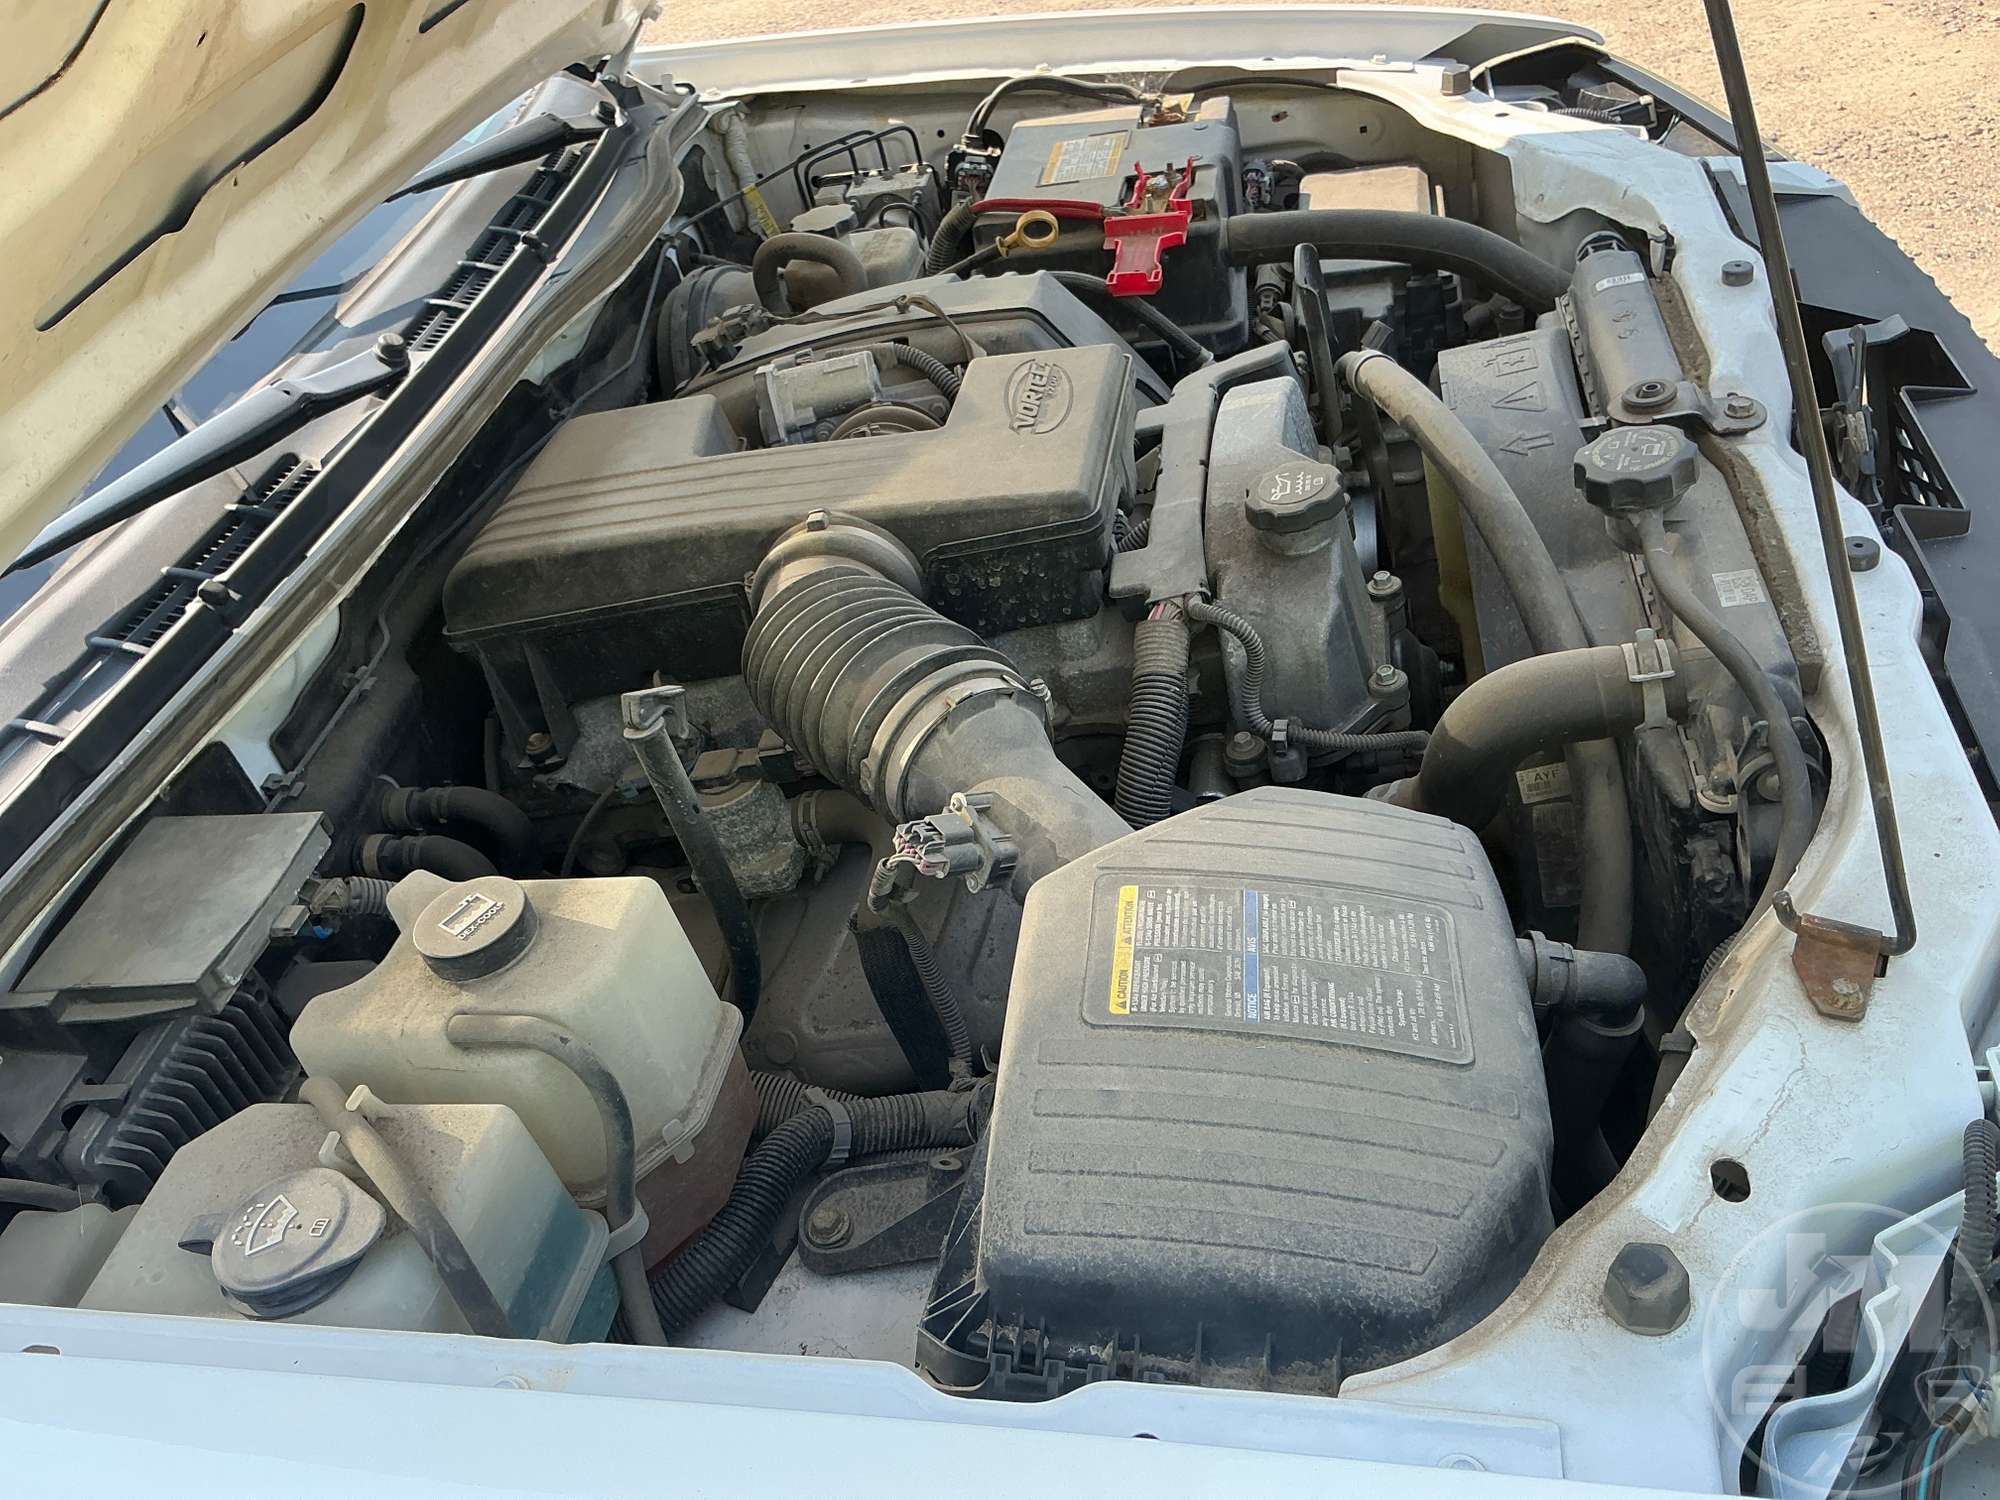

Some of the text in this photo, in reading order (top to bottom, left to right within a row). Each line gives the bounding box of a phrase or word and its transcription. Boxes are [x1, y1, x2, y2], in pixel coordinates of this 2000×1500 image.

[1533, 768, 1561, 783] AYF
[457, 902, 505, 940] DEX-COOL
[1122, 900, 1134, 934] ATTENTION
[1247, 937, 1256, 952] AVIS
[1116, 969, 1128, 998] CAUTION
[1247, 992, 1257, 1019] NOTICE
[1328, 982, 1337, 1018] CONDITIONING
